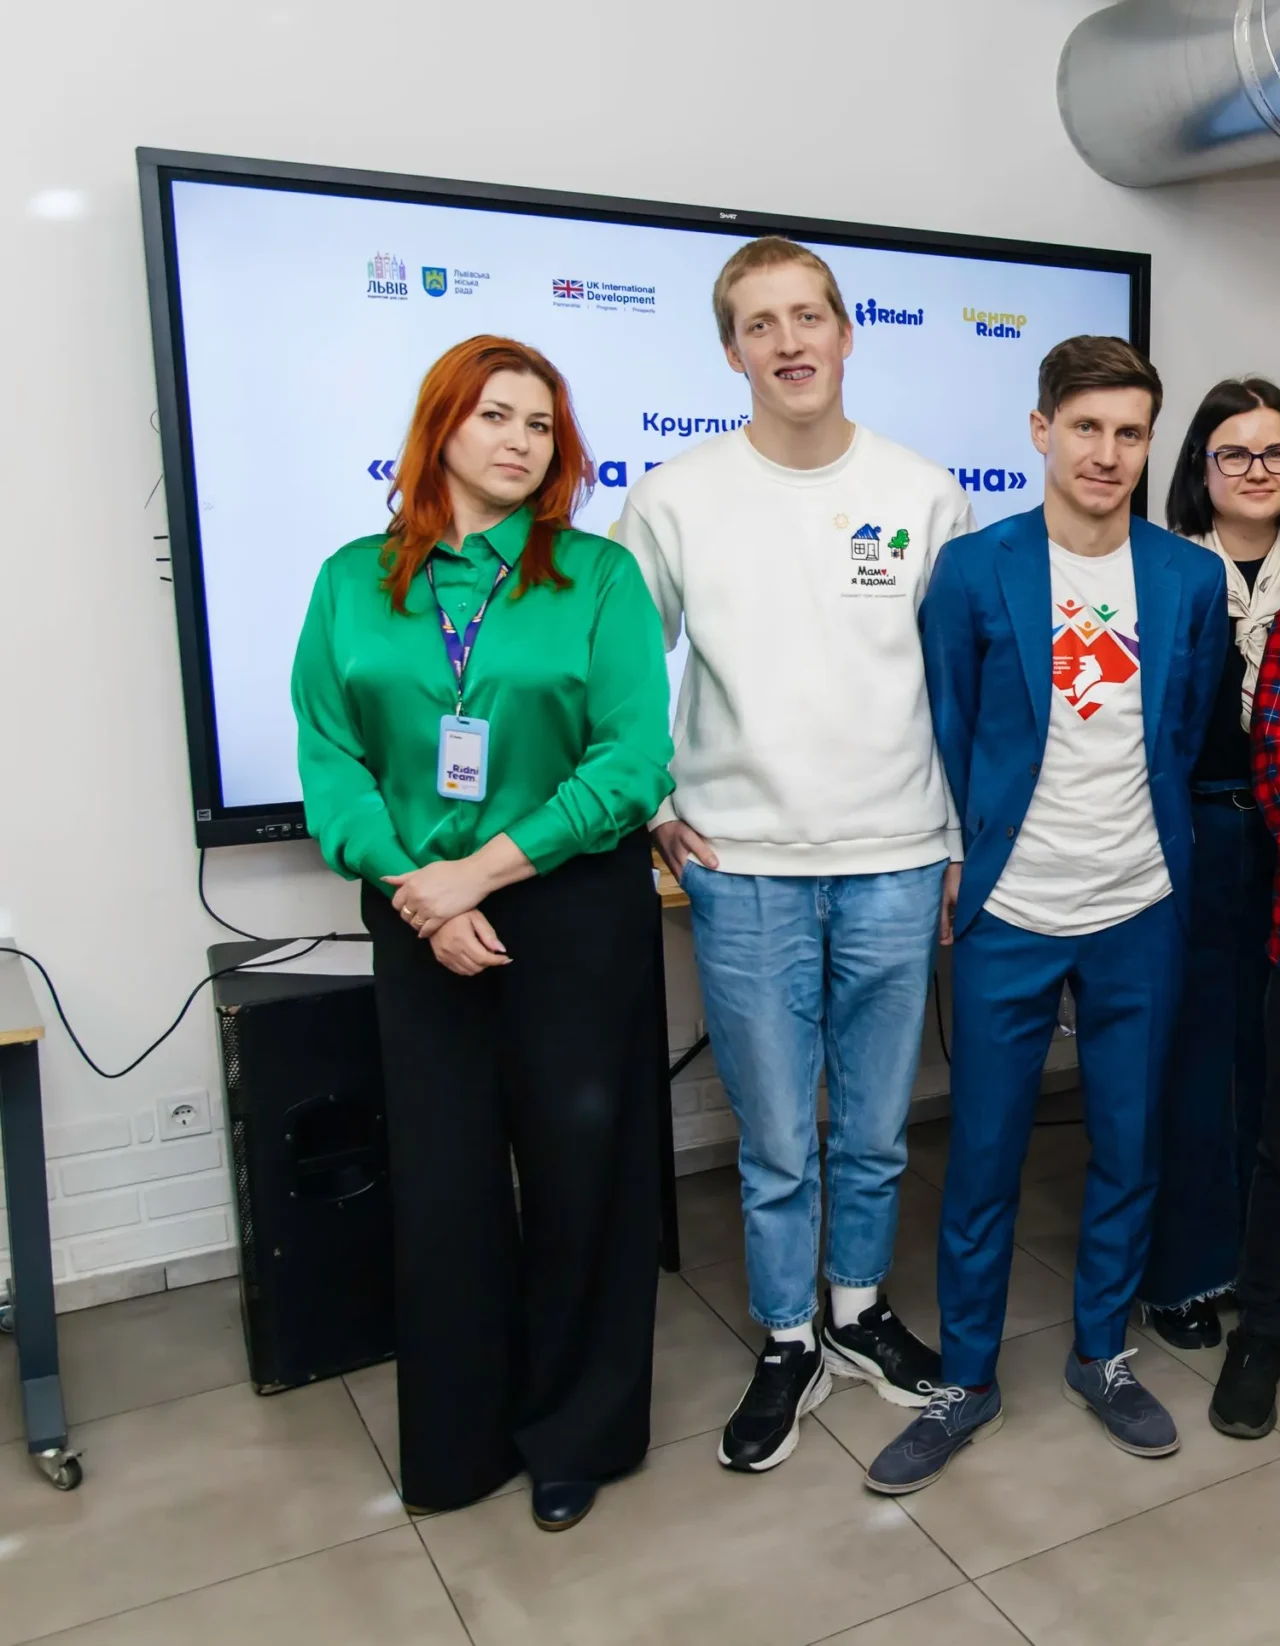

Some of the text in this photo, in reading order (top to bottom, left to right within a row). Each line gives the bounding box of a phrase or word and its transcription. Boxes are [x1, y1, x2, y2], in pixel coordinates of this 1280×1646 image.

[367, 280, 408, 296] ЛЬВІВ
[454, 287, 473, 295] рада
[586, 280, 656, 294] UK International
[587, 290, 656, 305] Development
[878, 308, 924, 326] Ridni
[962, 307, 1028, 330] Центр
[975, 321, 1021, 339] Ridni
[850, 576, 897, 587] я вдома!
[452, 764, 479, 776] Ridni
